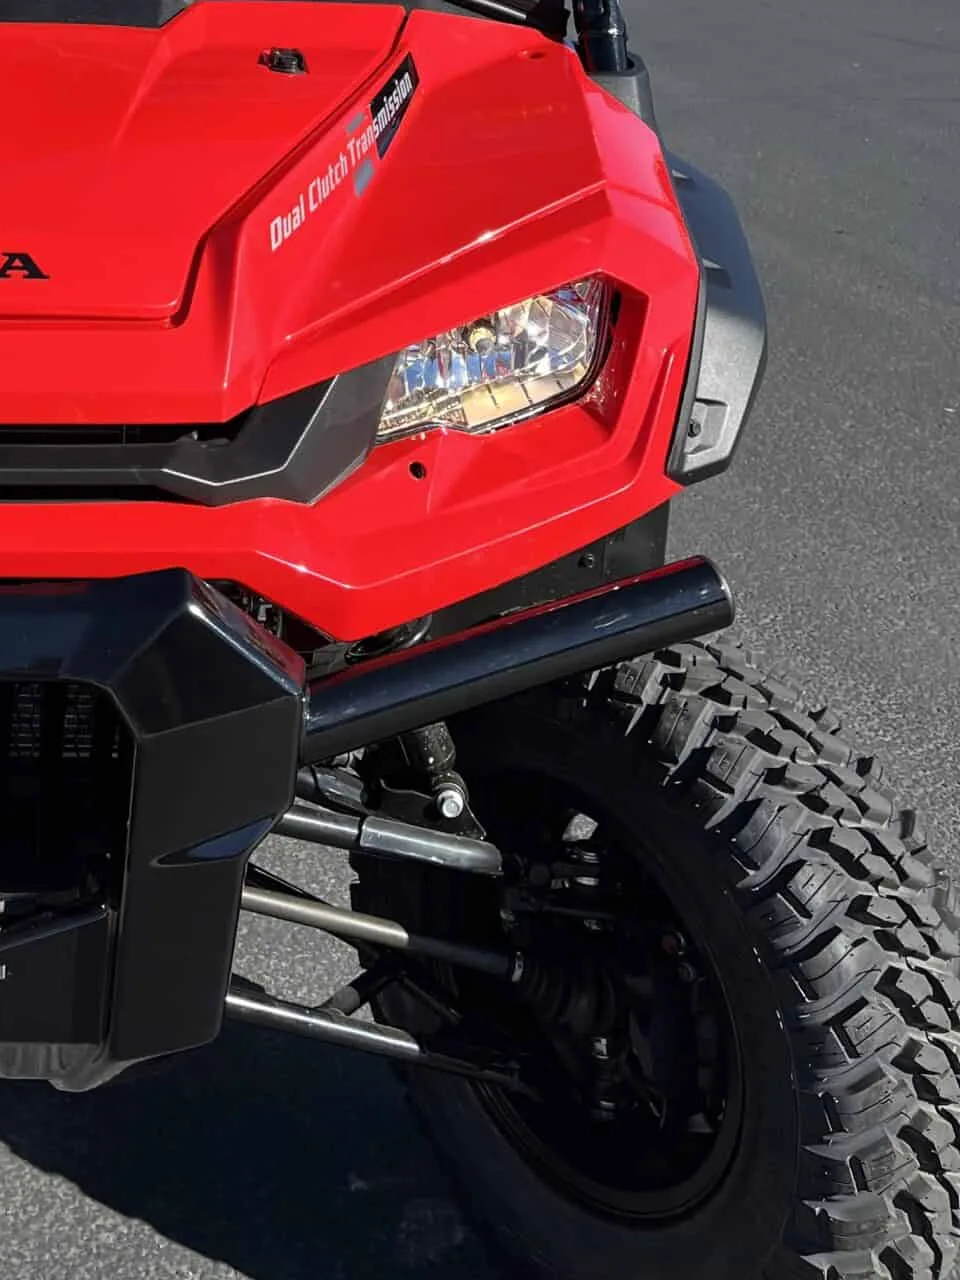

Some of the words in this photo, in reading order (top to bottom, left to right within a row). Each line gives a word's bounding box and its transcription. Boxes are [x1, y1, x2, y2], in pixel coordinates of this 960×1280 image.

[270, 194, 306, 252] Dual
[308, 152, 348, 213] Clutch
[347, 72, 413, 167] Transmission
